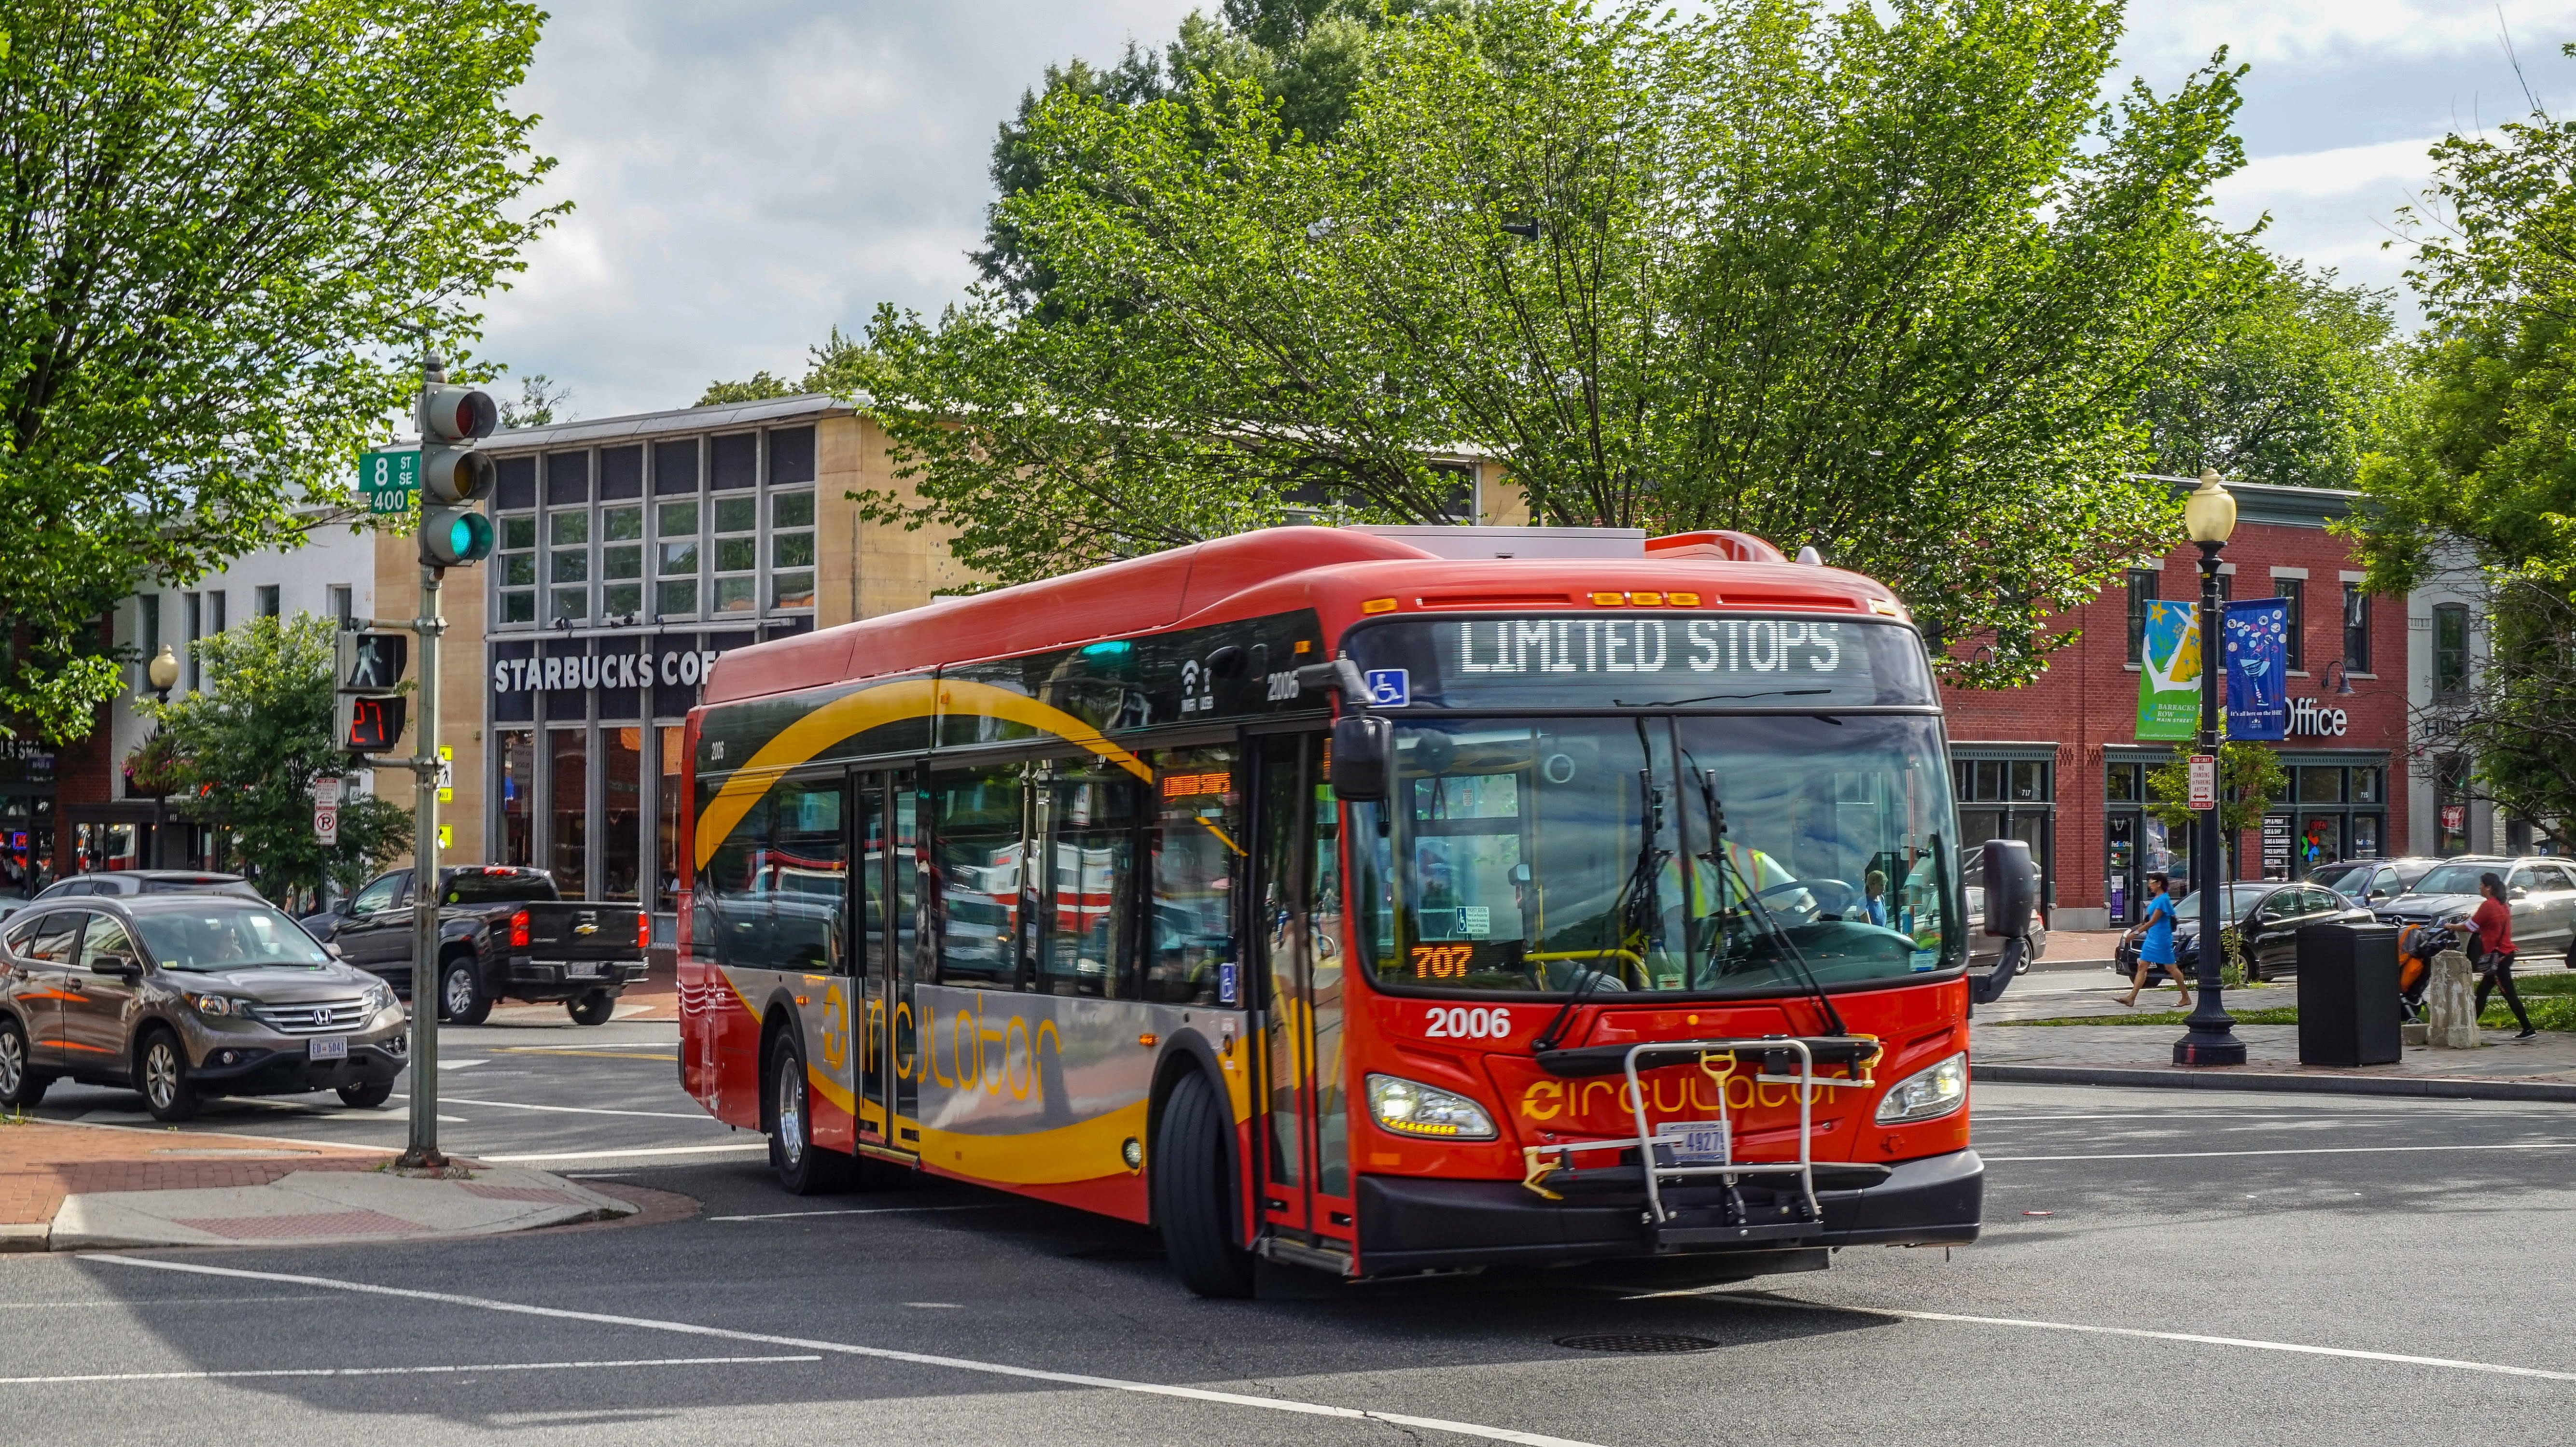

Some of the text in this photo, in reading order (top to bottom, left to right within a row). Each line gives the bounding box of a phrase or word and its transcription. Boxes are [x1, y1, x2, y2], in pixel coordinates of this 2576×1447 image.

[375, 456, 412, 487] 8 ST
[399, 472, 413, 485] SE
[375, 490, 404, 511] 400
[1461, 618, 1839, 673] LIMITED STOPS
[495, 653, 654, 693] STARBUCKS
[351, 702, 384, 744] 27
[711, 740, 724, 761] 2006
[2311, 821, 2326, 829] OPEN
[1412, 946, 1473, 979] 707
[1424, 1007, 1511, 1040] 2006
